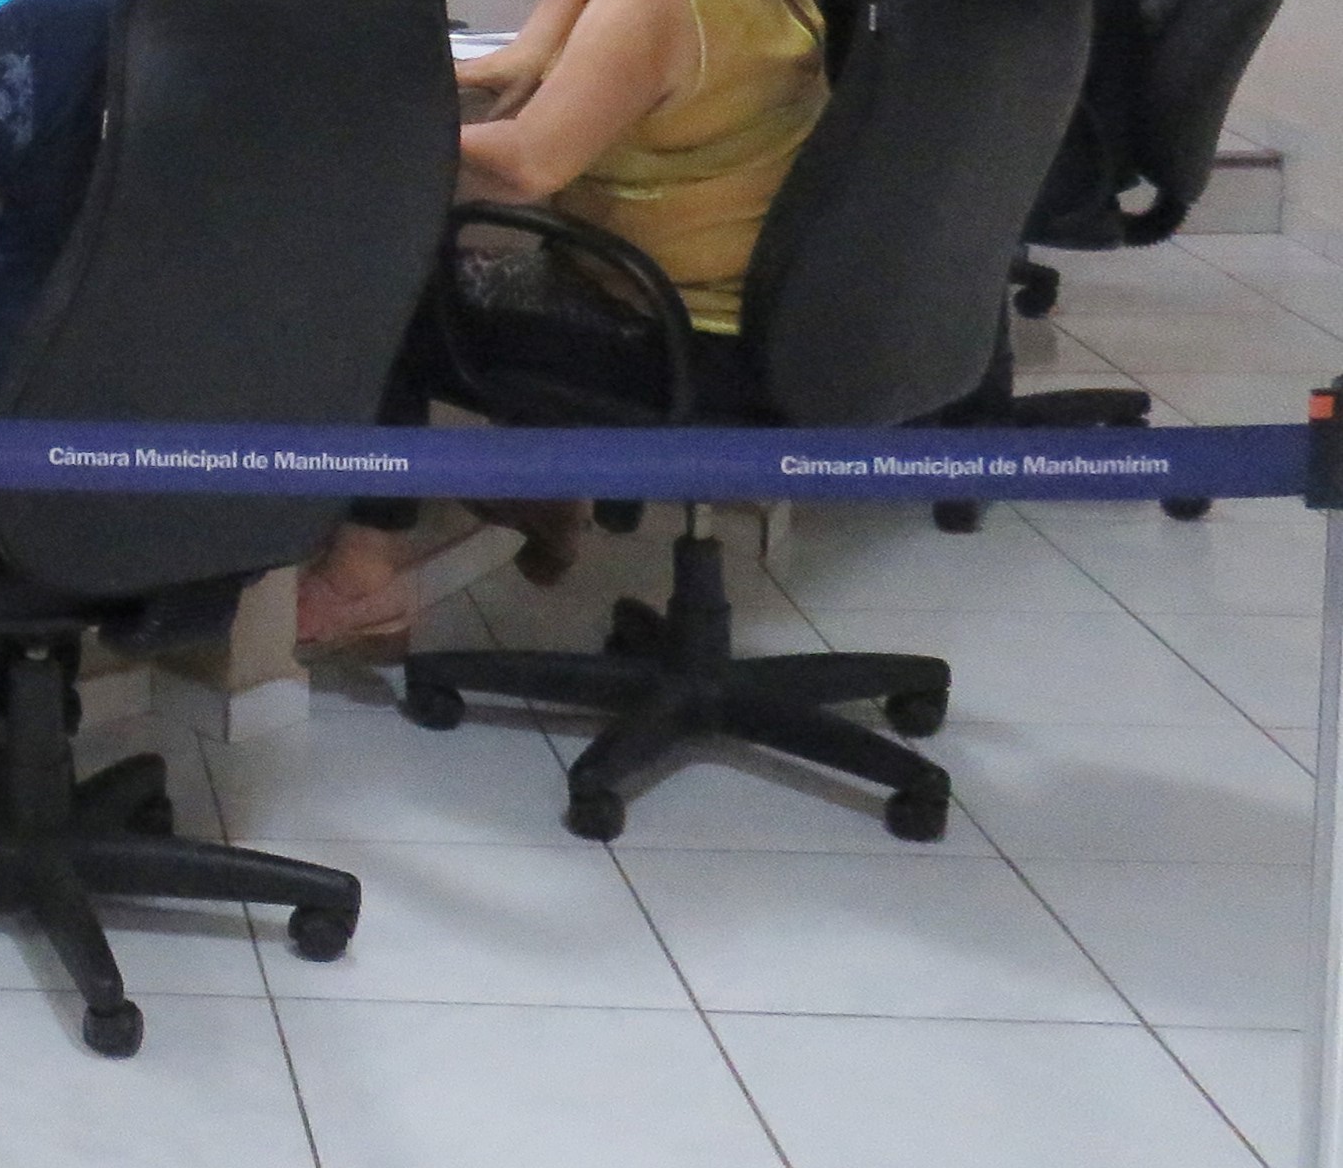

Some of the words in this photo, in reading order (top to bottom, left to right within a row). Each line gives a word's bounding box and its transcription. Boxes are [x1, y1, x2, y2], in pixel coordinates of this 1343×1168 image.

[49, 446, 129, 467] Câmara
[135, 448, 238, 471] Municipal
[242, 450, 269, 470] de
[274, 451, 409, 472] Manhumirim
[780, 455, 867, 475] Câmara
[873, 455, 984, 479] Municipal
[989, 456, 1016, 475] de
[1023, 455, 1170, 475] Manhumirim
